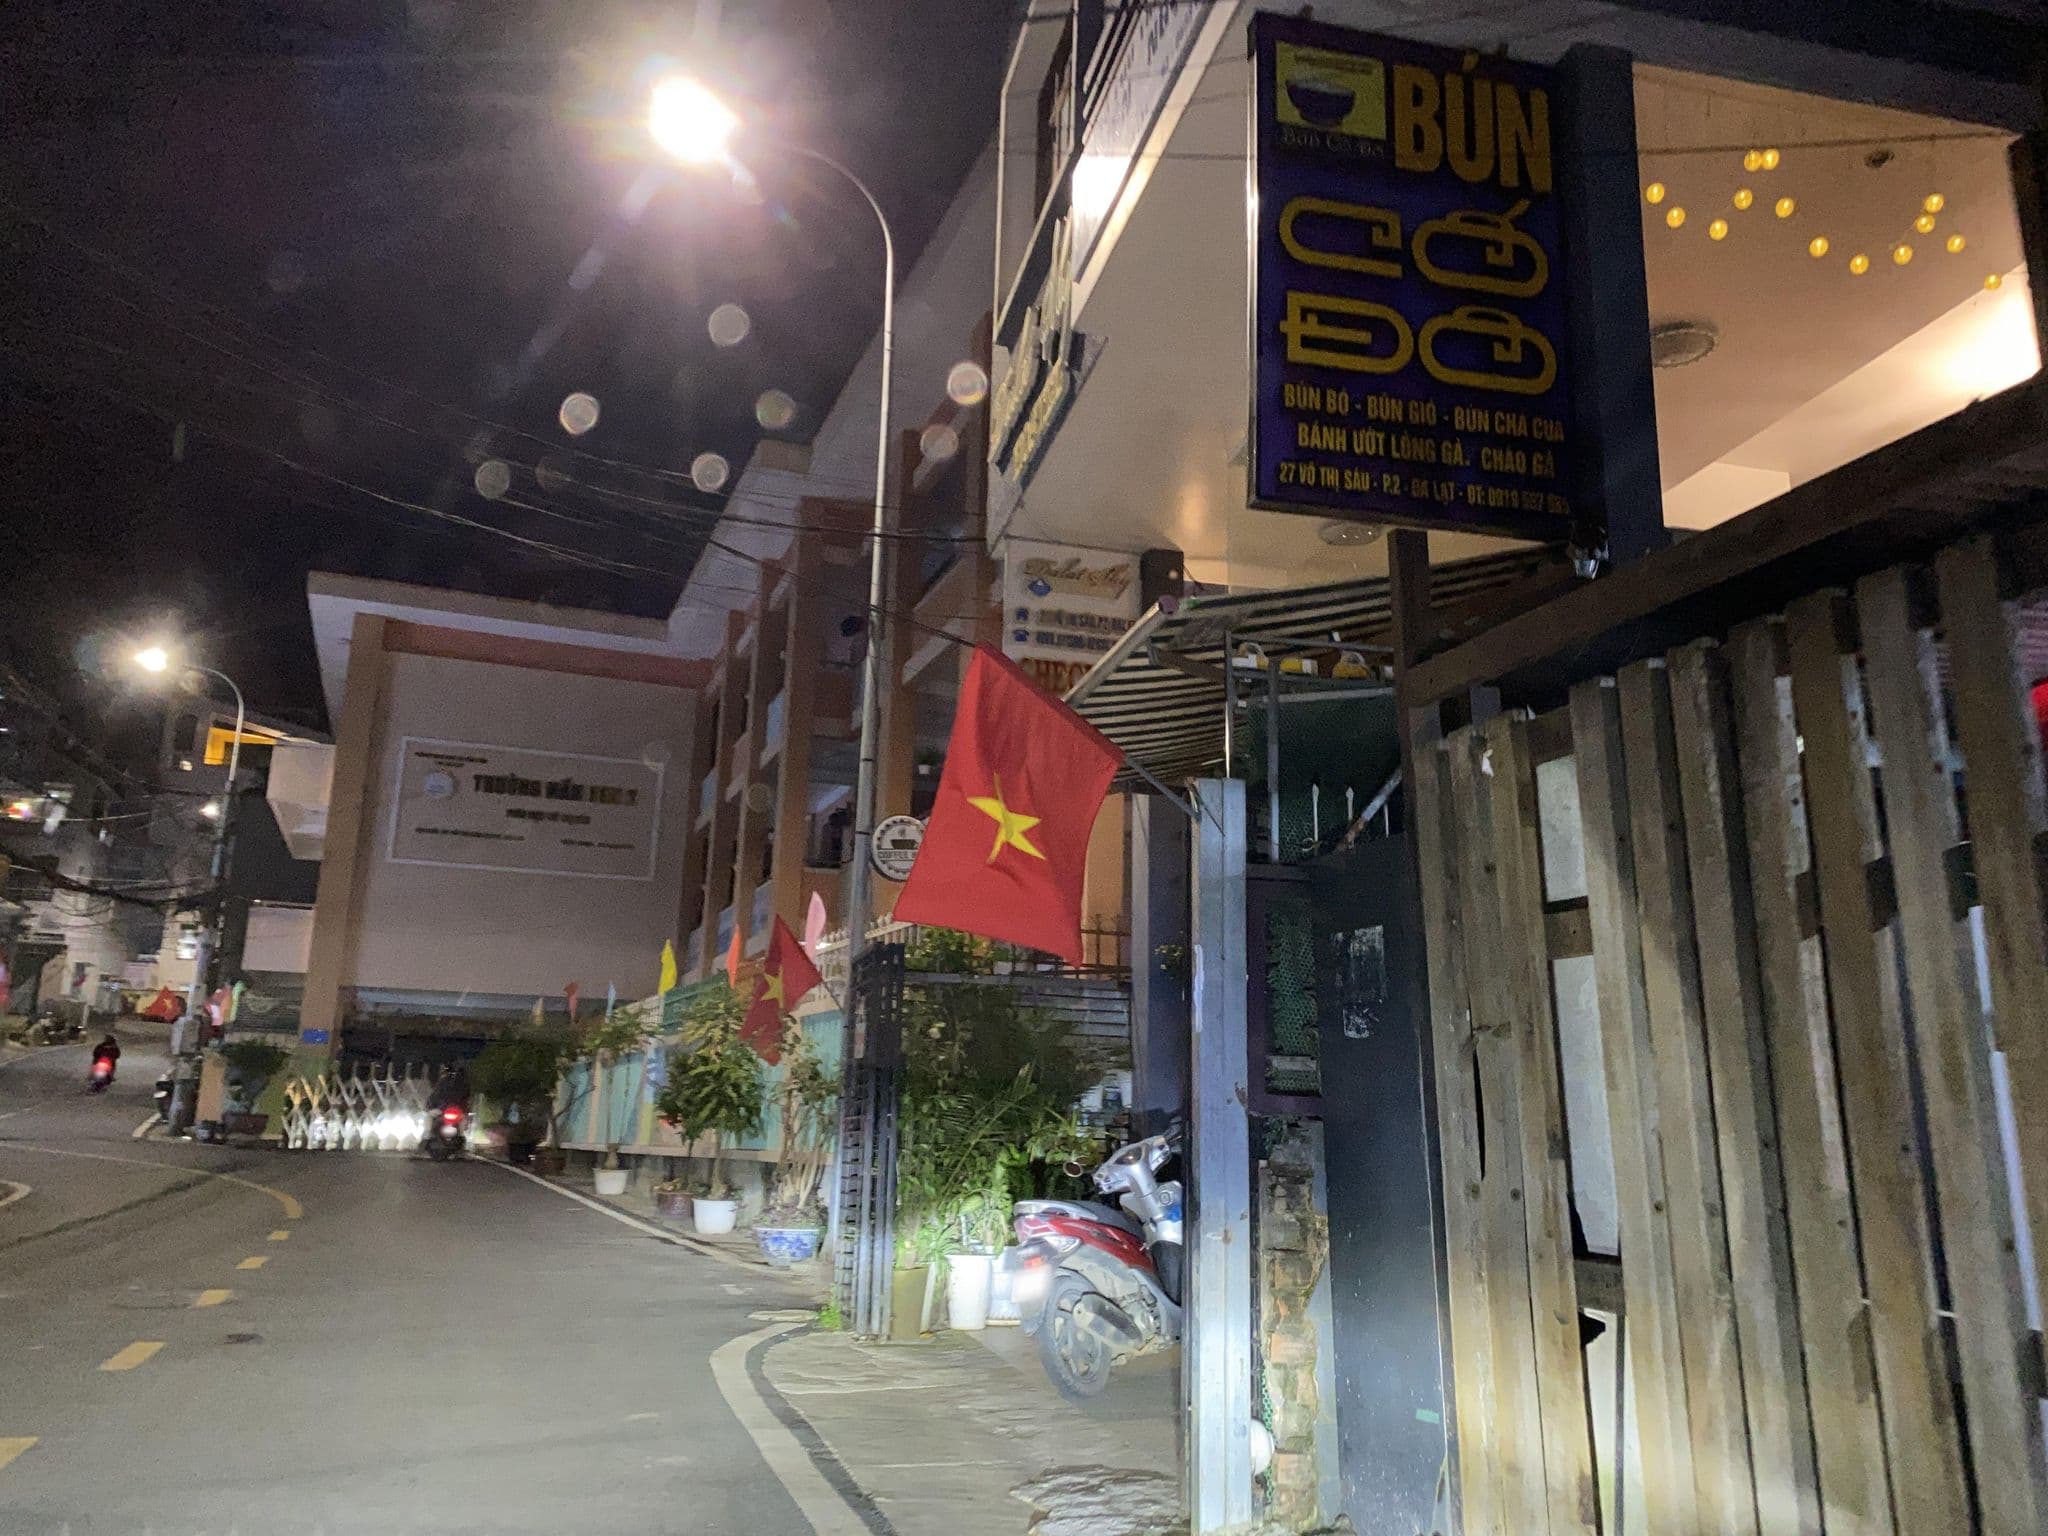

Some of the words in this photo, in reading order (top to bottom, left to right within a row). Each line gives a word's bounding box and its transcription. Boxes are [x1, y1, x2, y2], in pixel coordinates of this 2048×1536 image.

[1393, 52, 1552, 194] BÚN
[1284, 380, 1321, 411] BÚN
[1367, 392, 1403, 423] BÚN
[1454, 403, 1490, 433] BÚN
[1298, 420, 1346, 451] BÁNH
[1279, 462, 1295, 484] 27
[1319, 465, 1340, 493] THỊ
